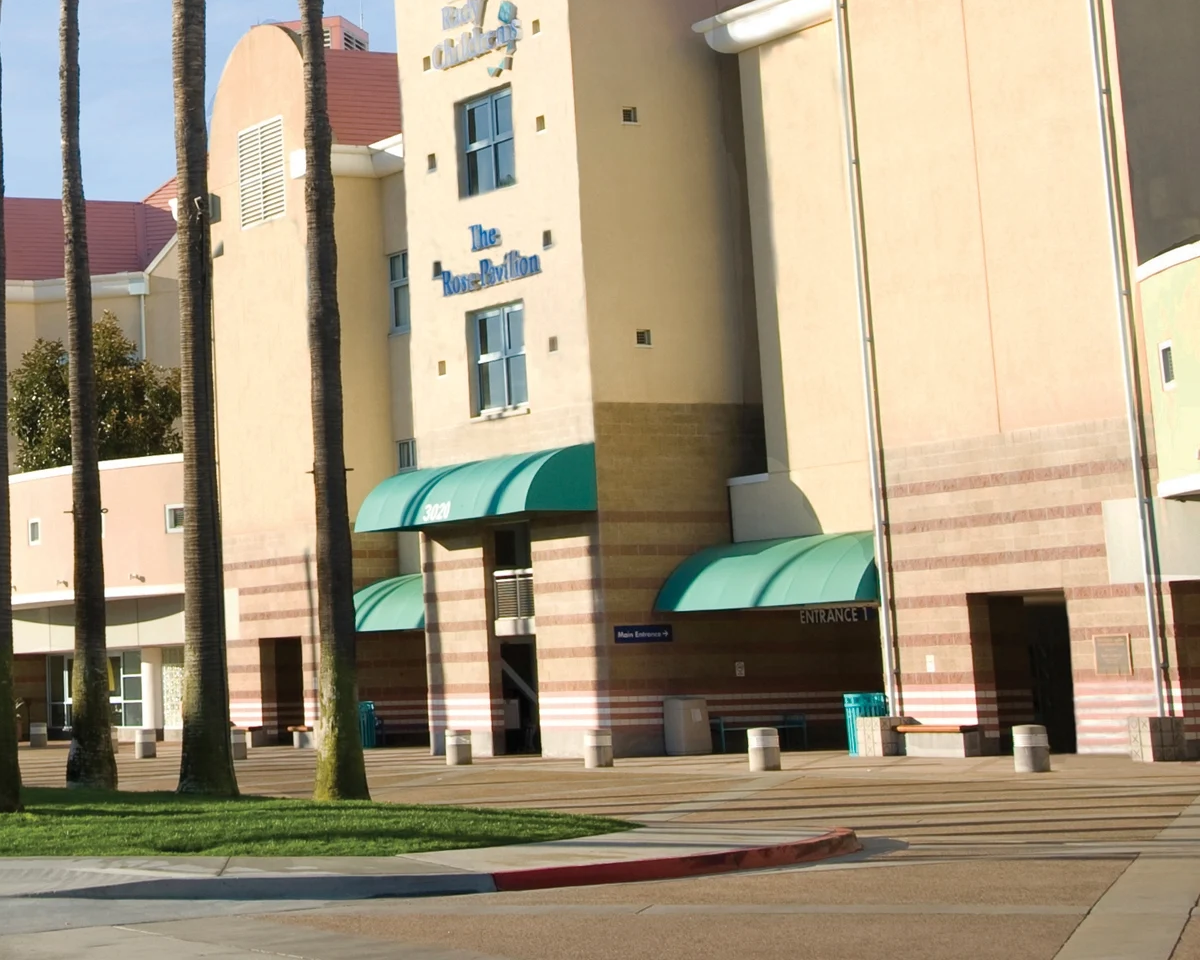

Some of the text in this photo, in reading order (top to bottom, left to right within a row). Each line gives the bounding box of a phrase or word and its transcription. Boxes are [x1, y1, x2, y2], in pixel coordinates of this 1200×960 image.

[468, 224, 502, 252] The
[441, 249, 542, 297] Rose Pavilion
[422, 500, 451, 522] 3020
[800, 606, 868, 624] ENTRANCE 1
[635, 630, 661, 638] Entrance
